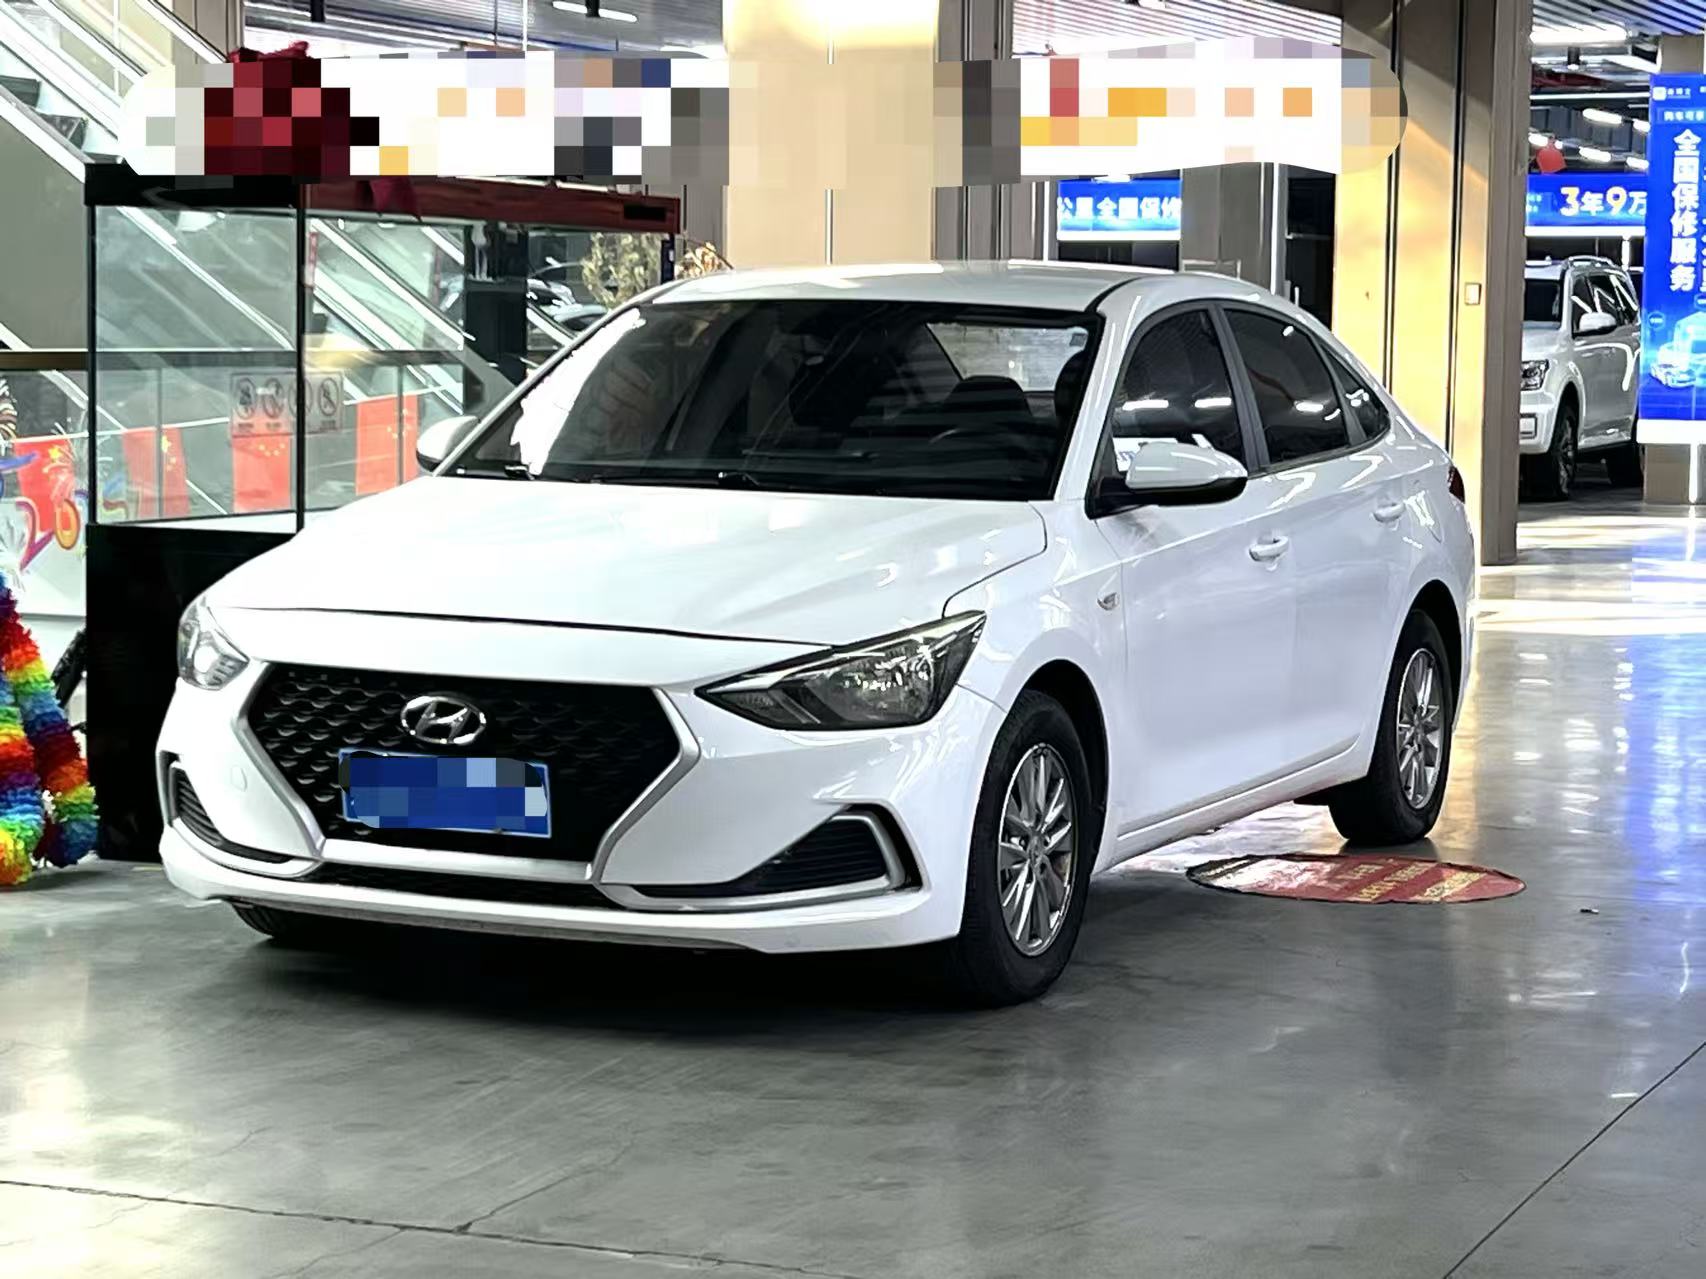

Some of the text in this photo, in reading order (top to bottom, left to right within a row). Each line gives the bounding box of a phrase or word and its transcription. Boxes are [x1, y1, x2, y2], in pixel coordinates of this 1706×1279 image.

[1559, 185, 1648, 217] 3年9万
[1670, 128, 1701, 291] 全国保修服务
